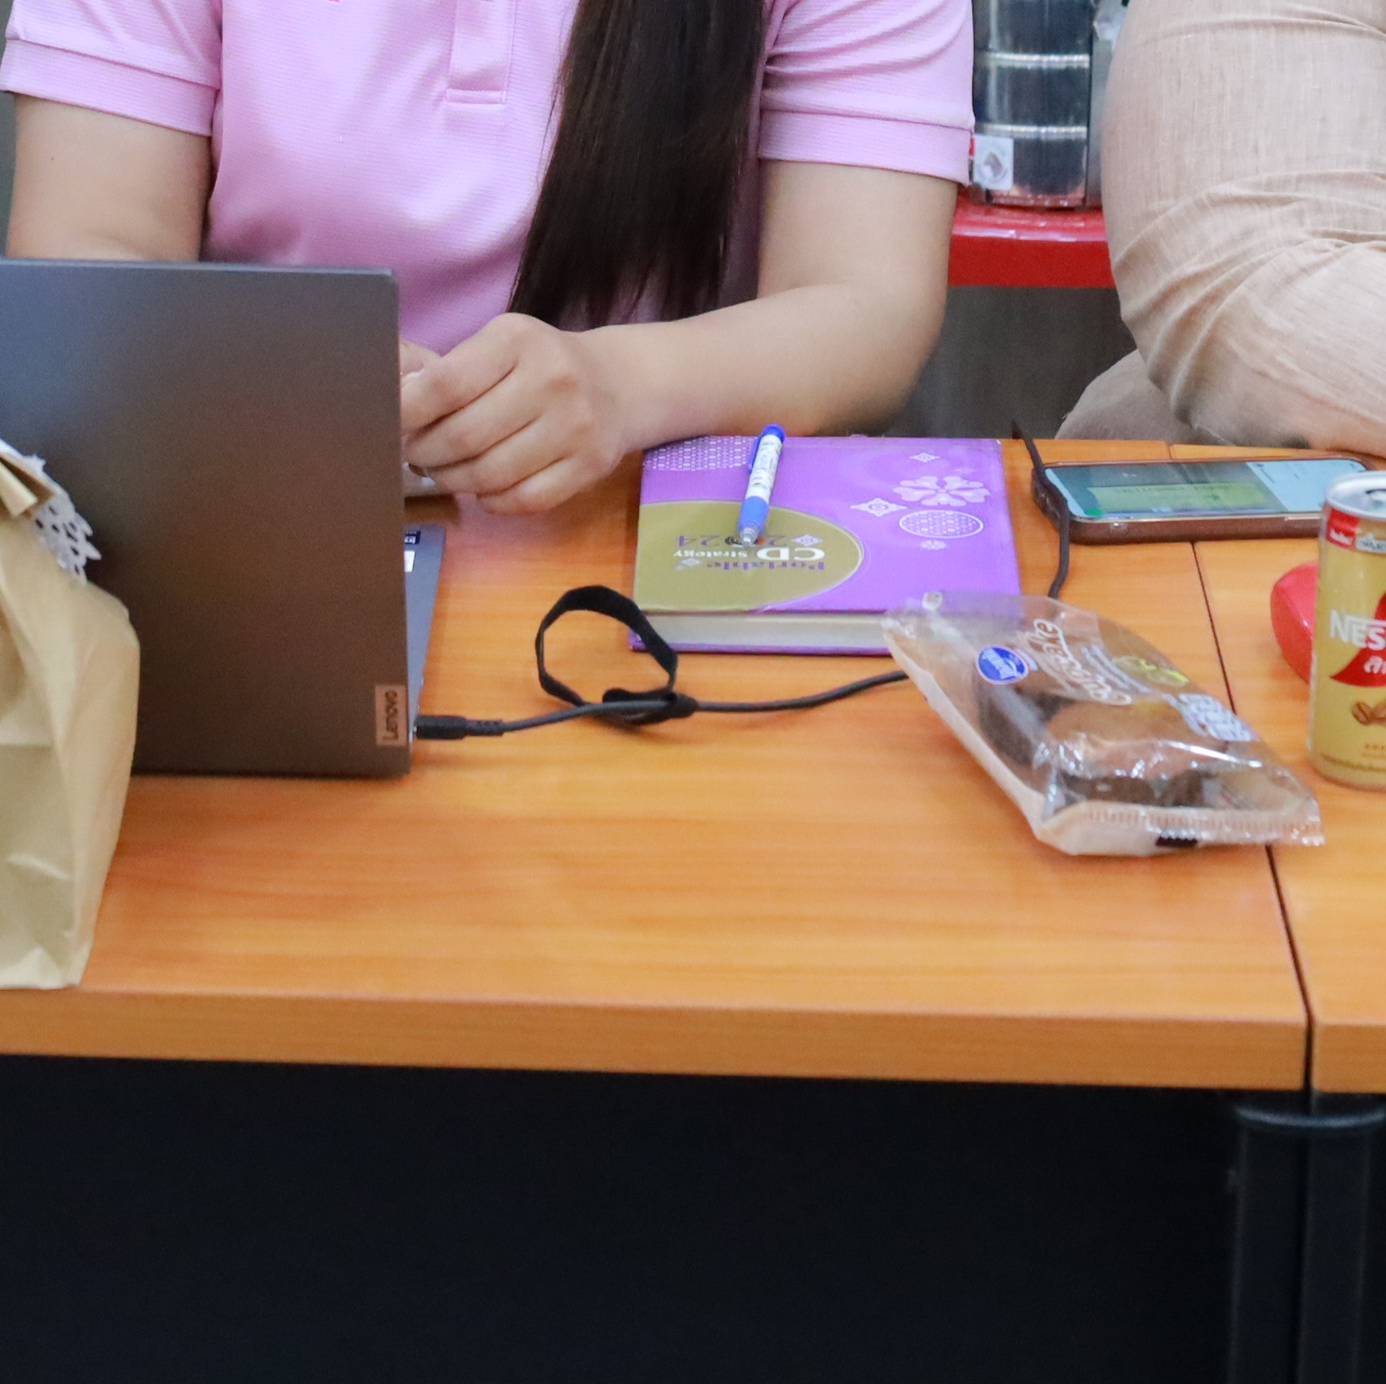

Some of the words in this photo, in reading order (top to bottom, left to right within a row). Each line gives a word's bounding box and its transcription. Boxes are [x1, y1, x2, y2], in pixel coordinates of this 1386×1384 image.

[756, 547, 825, 561] CD
[707, 561, 825, 570] Portable
[383, 689, 399, 741] Lenovo
